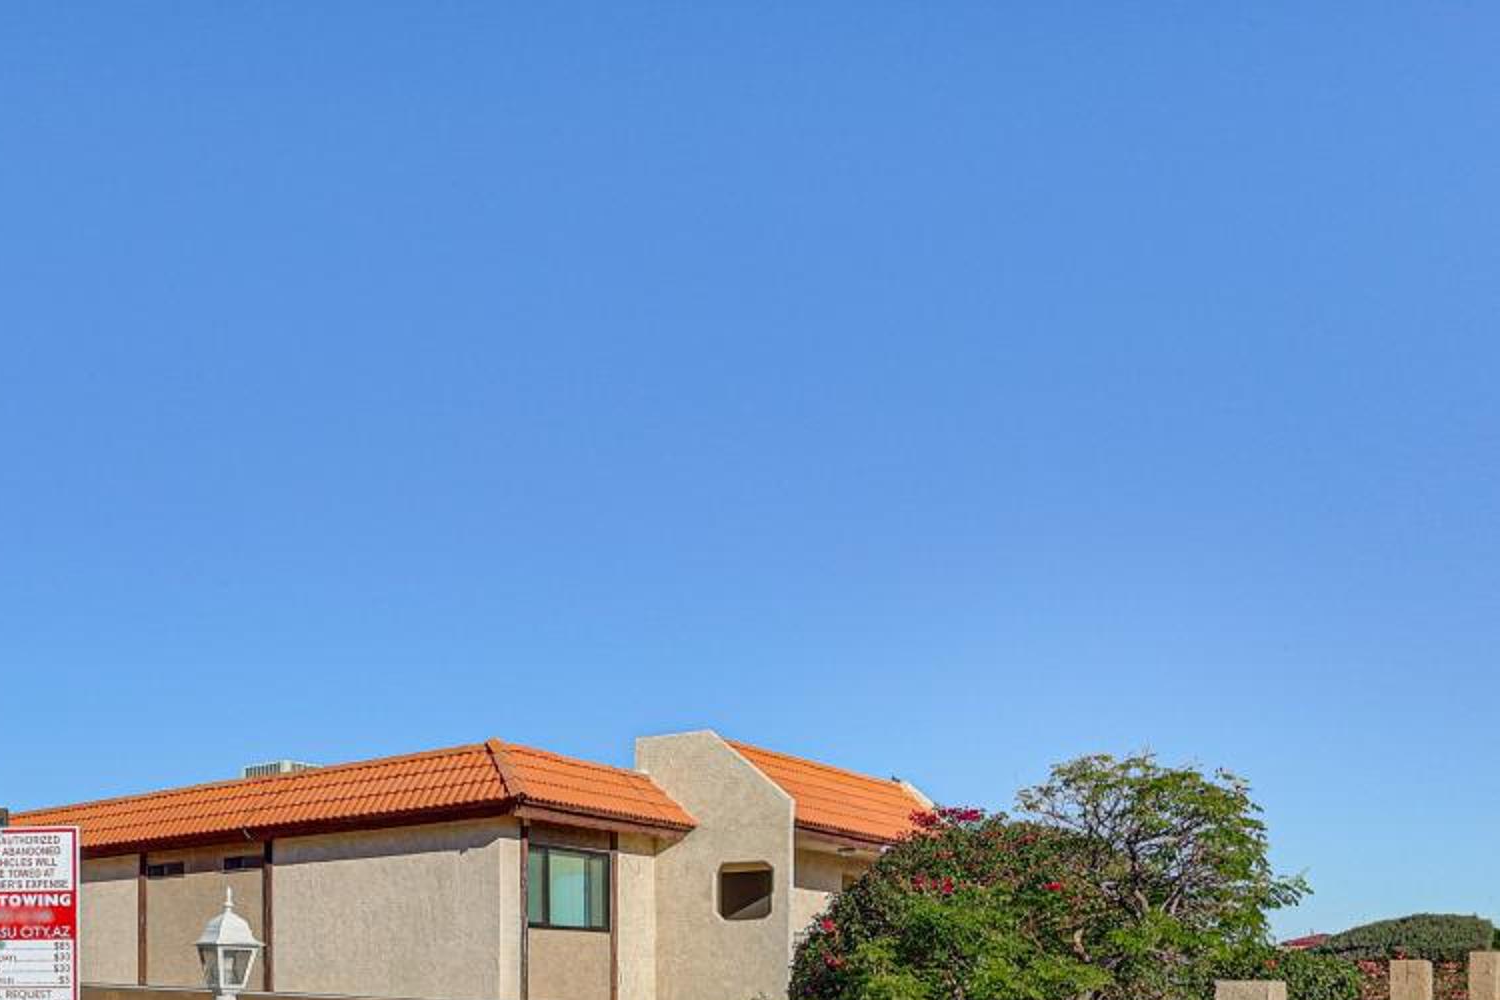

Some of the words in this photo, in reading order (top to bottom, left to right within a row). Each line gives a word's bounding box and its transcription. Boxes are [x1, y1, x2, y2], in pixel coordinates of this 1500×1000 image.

[2, 846, 60, 856] ABANDONED
[35, 858, 58, 867] WILL
[8, 868, 41, 878] TOWED
[43, 868, 55, 877] AT
[25, 880, 69, 889] EXPENSE
[5, 989, 52, 999] REQUEST
